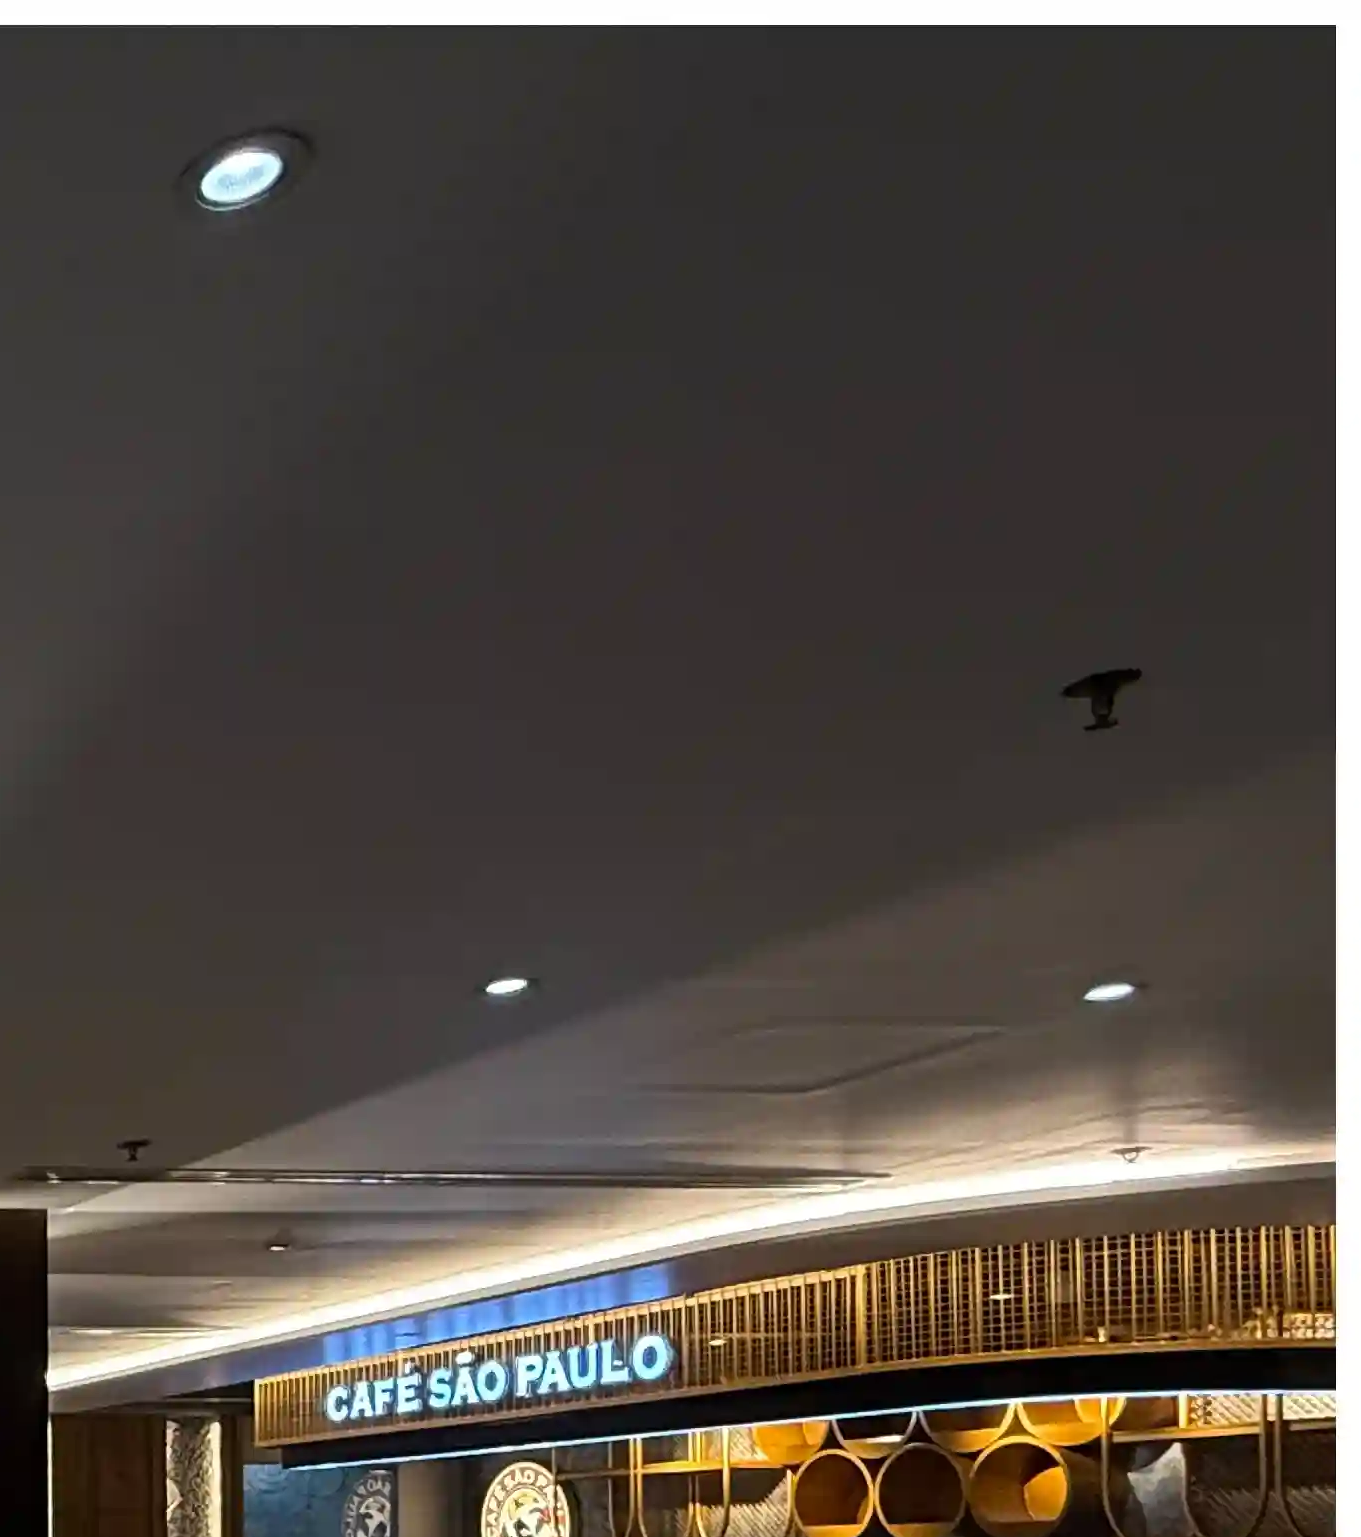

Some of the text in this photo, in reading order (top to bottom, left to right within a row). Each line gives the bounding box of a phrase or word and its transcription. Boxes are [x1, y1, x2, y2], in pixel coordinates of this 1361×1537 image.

[326, 1335, 673, 1422] CAFÉ SÃO PAULO
